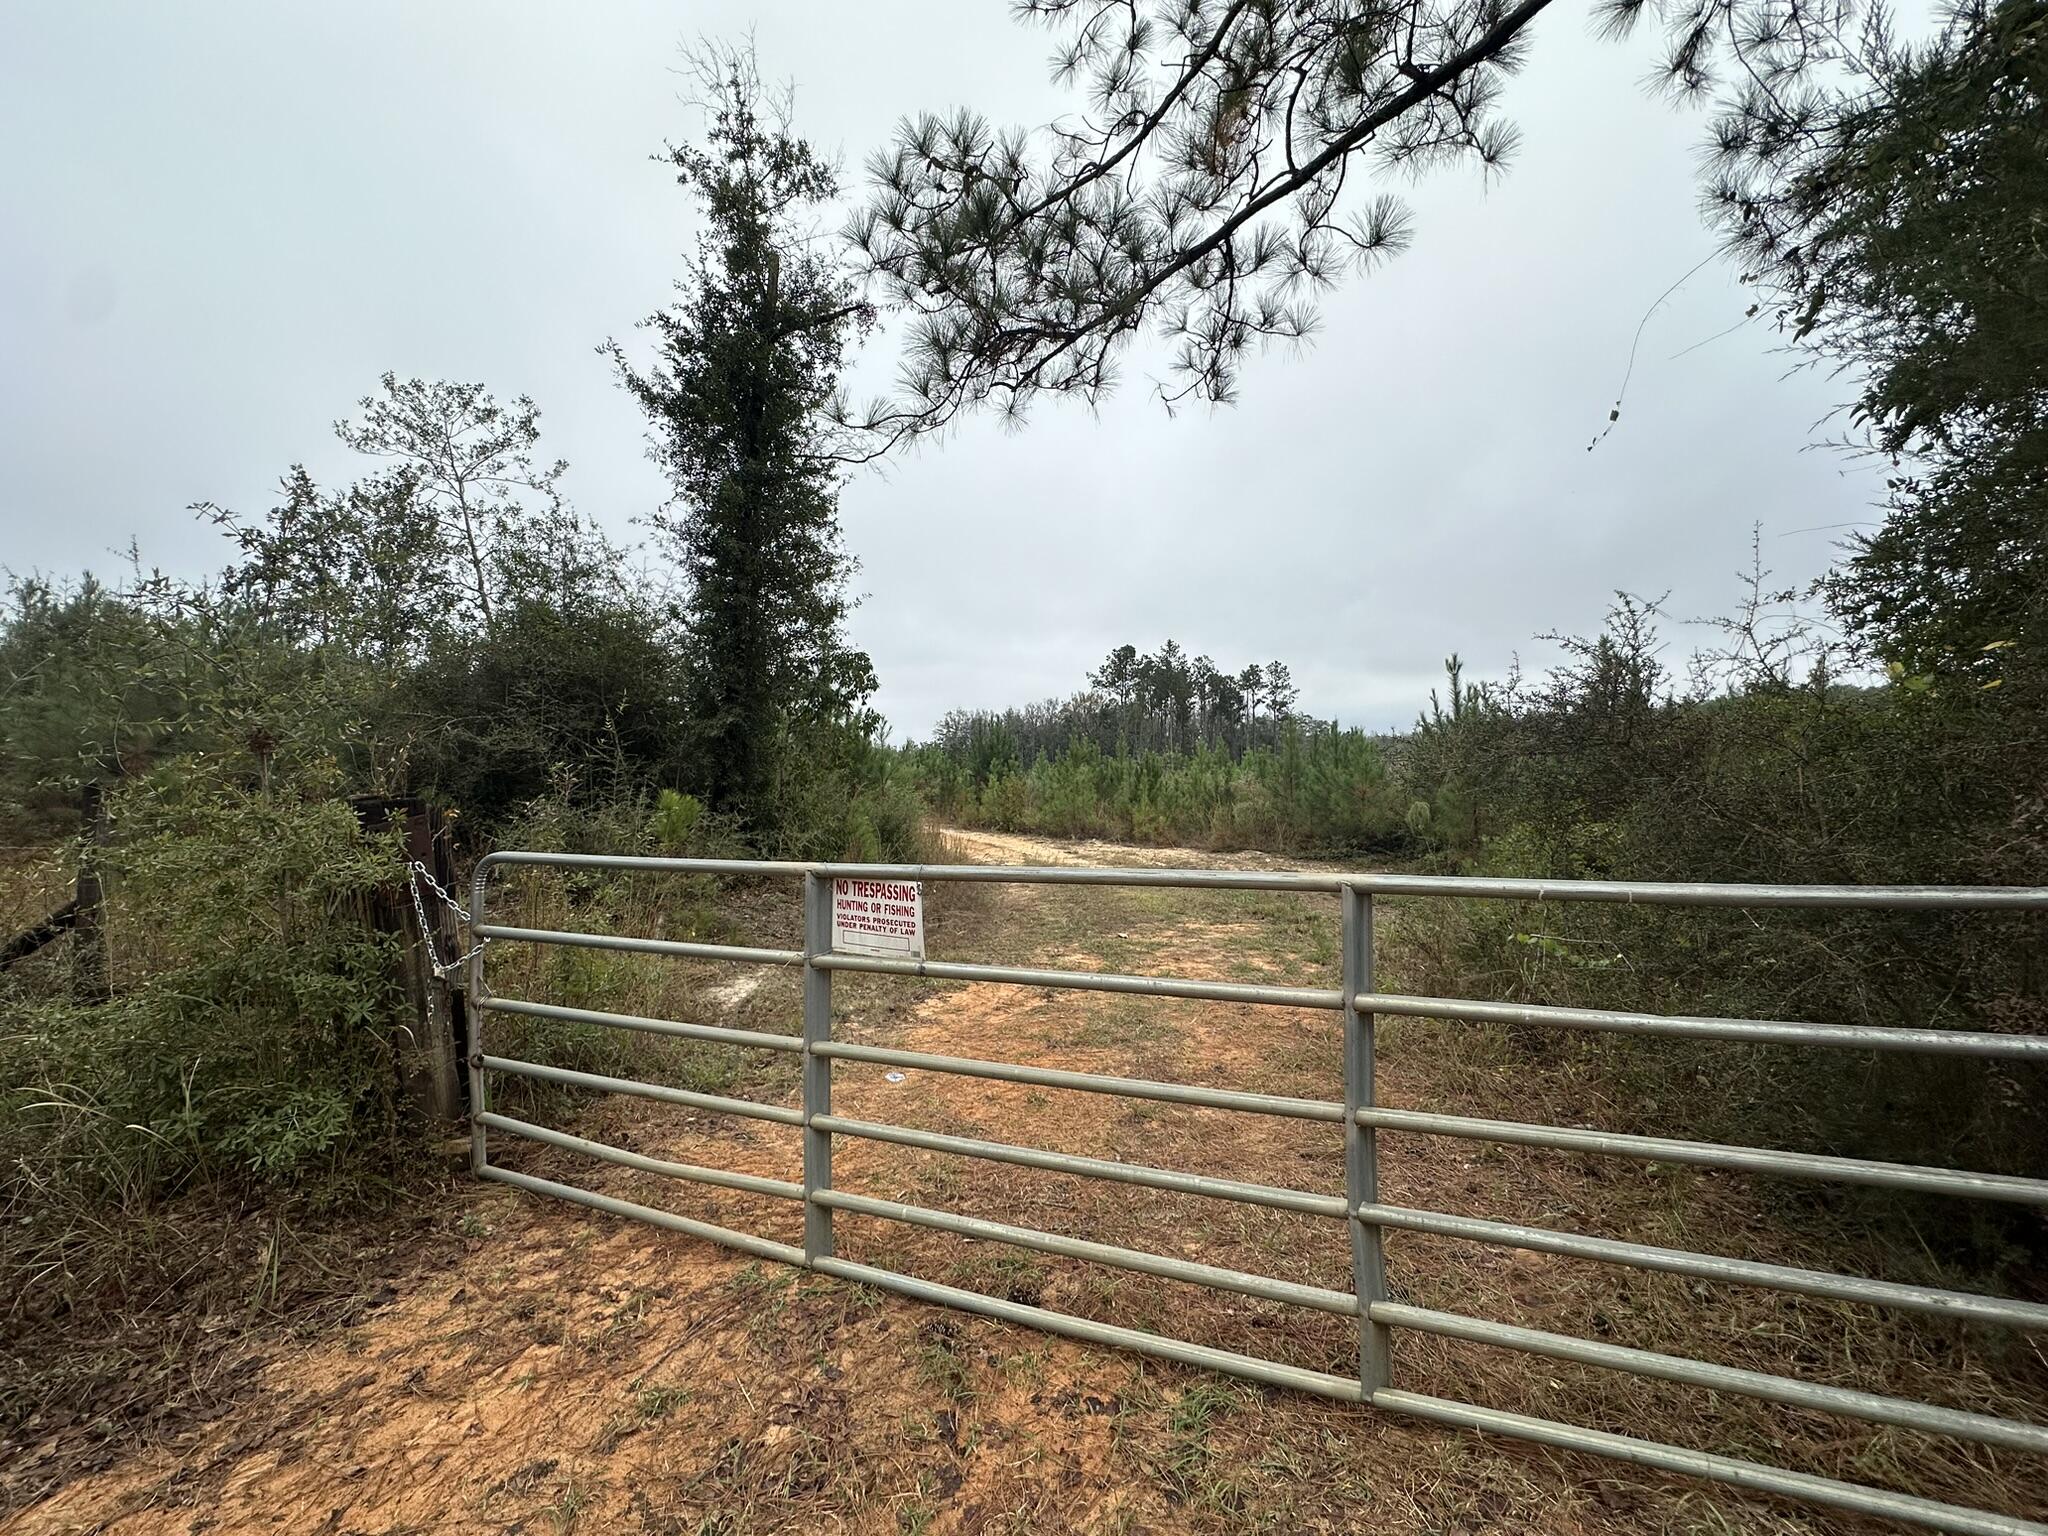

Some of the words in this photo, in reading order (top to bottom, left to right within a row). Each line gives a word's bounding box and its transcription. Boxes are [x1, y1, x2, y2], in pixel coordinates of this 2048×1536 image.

[836, 880, 848, 895] NO
[852, 881, 916, 902] TRESPASSING
[837, 899, 868, 912] HUNTING
[871, 903, 881, 913] OR
[884, 904, 915, 917] FISHING
[837, 913, 870, 923] VIOLATORS
[873, 918, 915, 928] PROSECUTED
